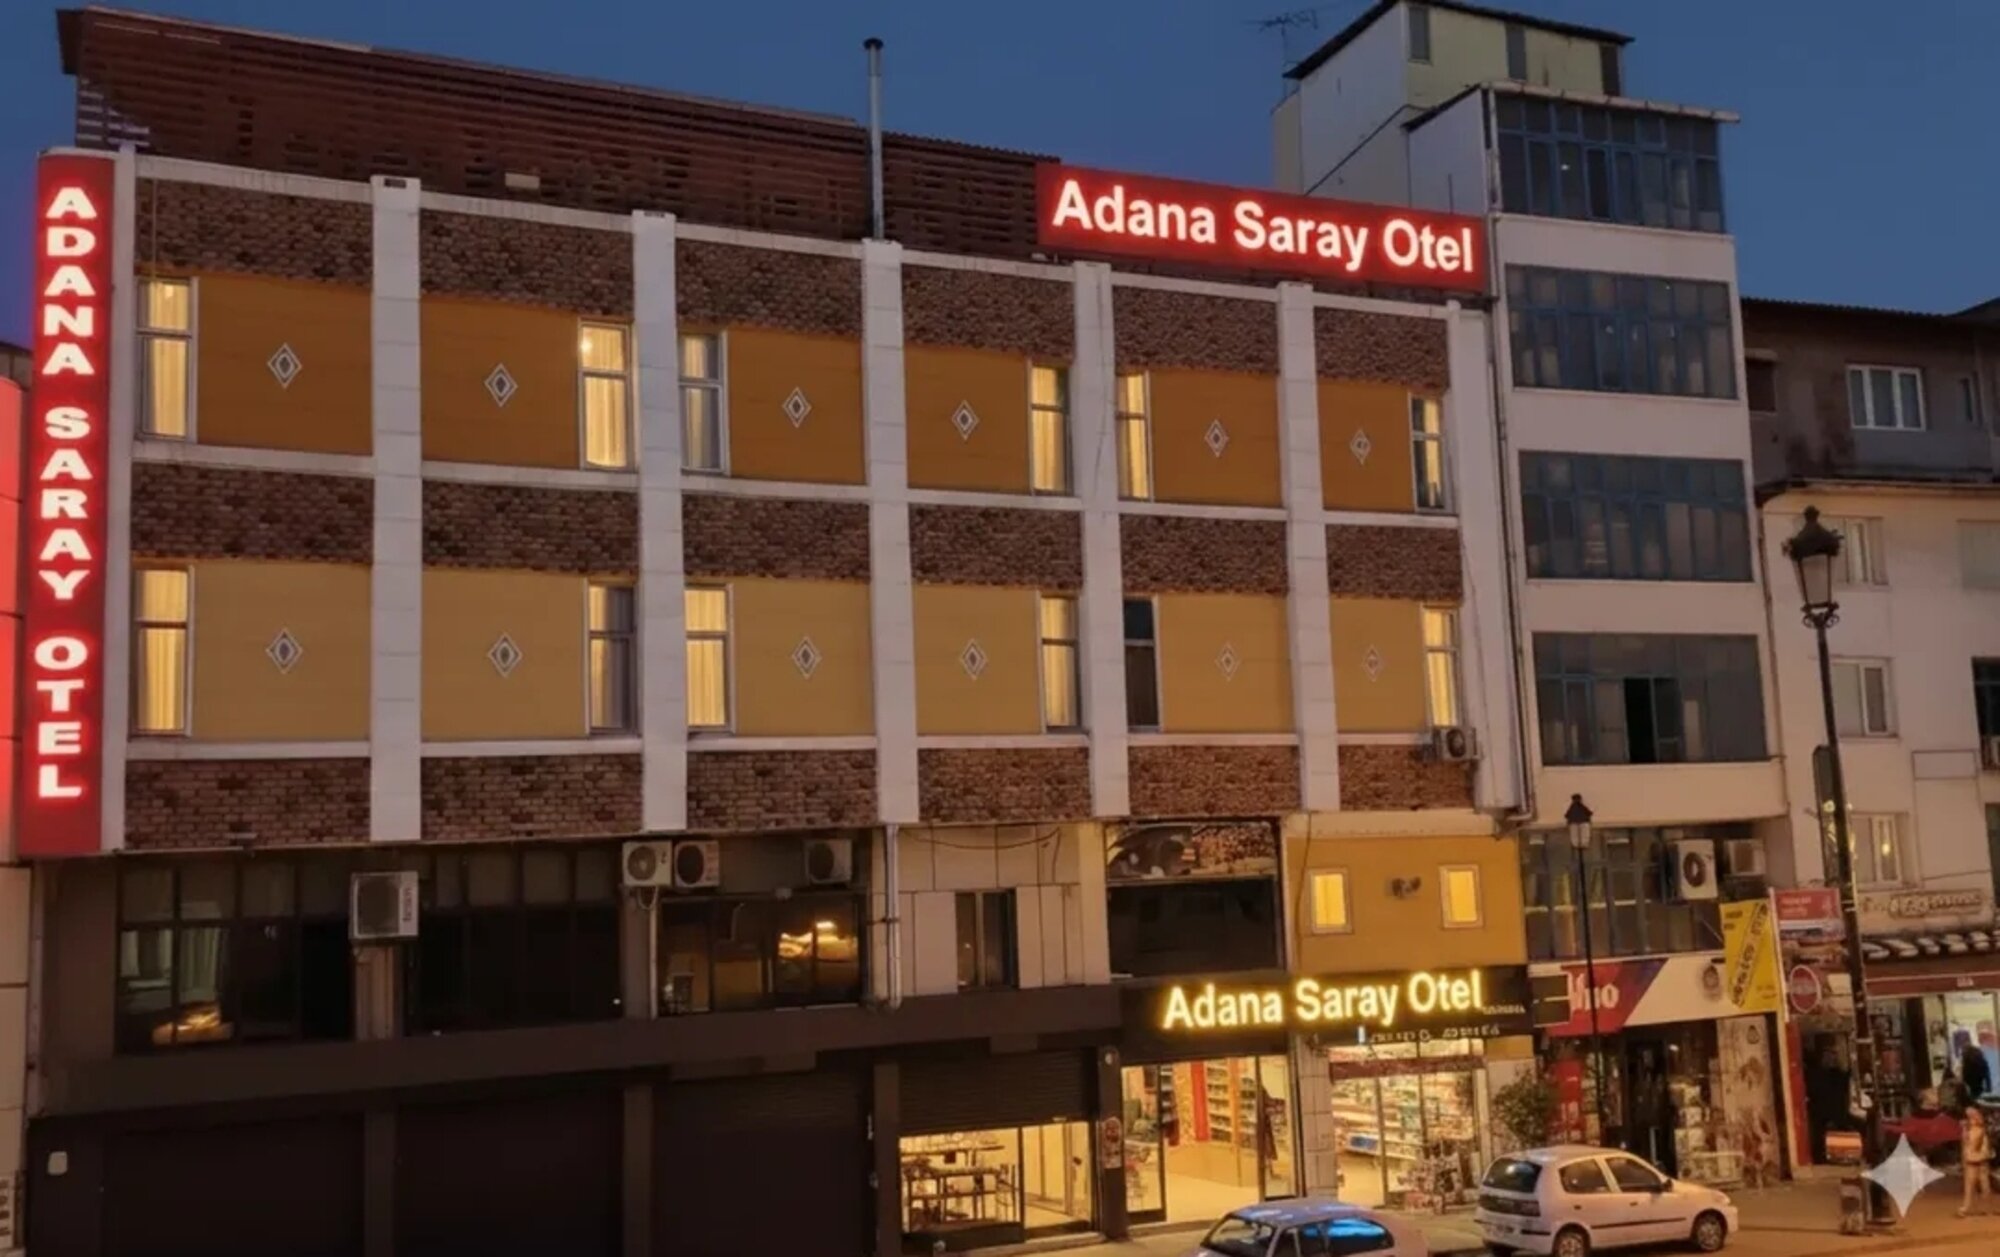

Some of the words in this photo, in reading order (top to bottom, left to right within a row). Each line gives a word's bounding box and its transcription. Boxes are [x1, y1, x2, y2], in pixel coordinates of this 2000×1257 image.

[42, 187, 97, 375] ADANA
[1052, 180, 1216, 243] Adana
[1234, 201, 1368, 272] Saray
[1383, 219, 1473, 272] Otel
[39, 406, 92, 600] SARAY
[34, 636, 88, 798] OTEL
[1163, 983, 1283, 1029] Adana
[1295, 979, 1399, 1026] Saray
[1407, 970, 1482, 1013] Otel
